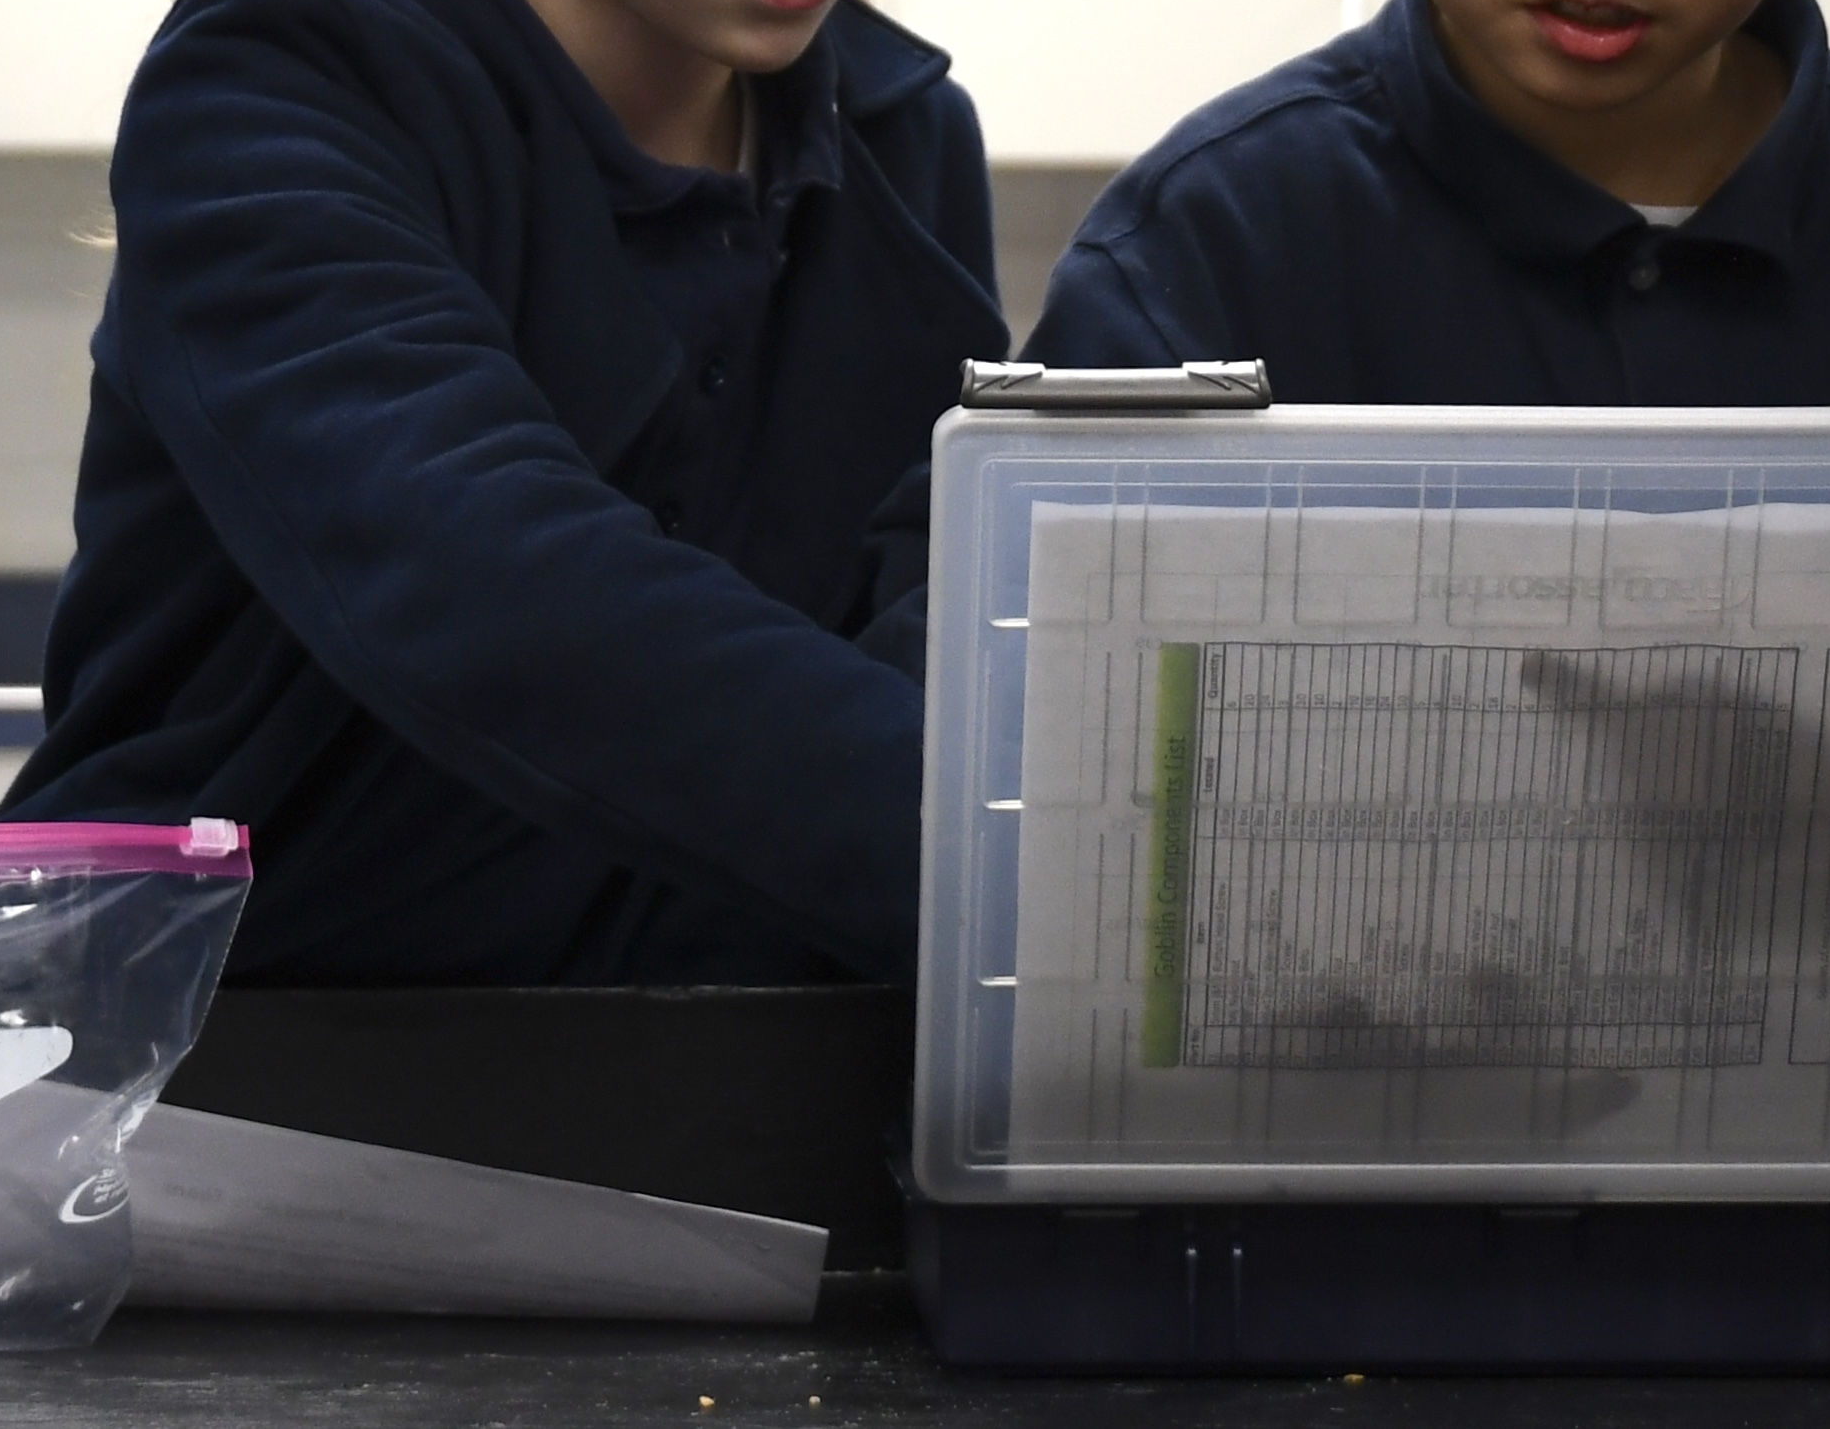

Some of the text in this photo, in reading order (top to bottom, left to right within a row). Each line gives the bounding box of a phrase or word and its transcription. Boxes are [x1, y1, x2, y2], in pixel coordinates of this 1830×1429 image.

[1207, 653, 1222, 699] Quantity
[1163, 735, 1186, 768] List
[1152, 911, 1177, 977] Goblin
